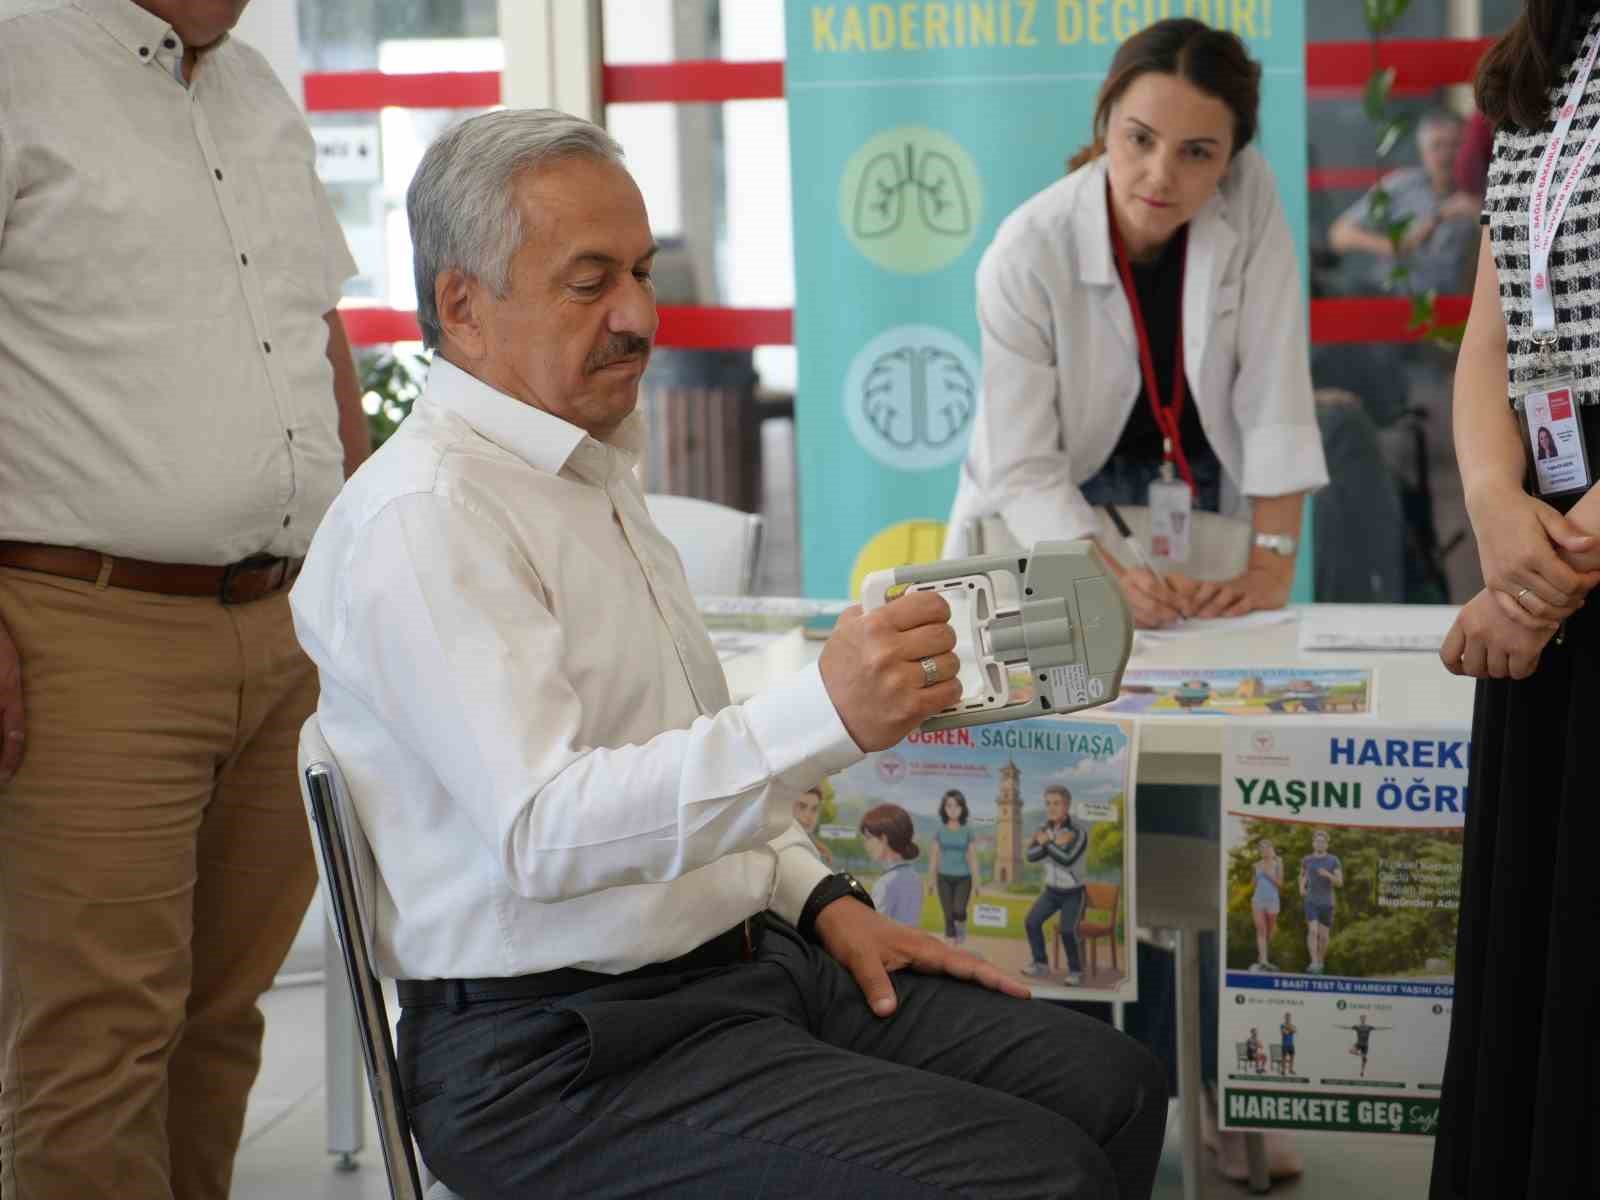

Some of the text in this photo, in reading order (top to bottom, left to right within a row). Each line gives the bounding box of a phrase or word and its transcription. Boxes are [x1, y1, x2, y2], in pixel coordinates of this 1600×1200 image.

[981, 727, 1061, 752] SAĞLIKLI
[1066, 733, 1115, 758] YAŞA
[1234, 777, 1362, 814] YAŞINI
[1230, 1095, 1350, 1123] HAREKETE
[1357, 1102, 1403, 1130] GEÇ
